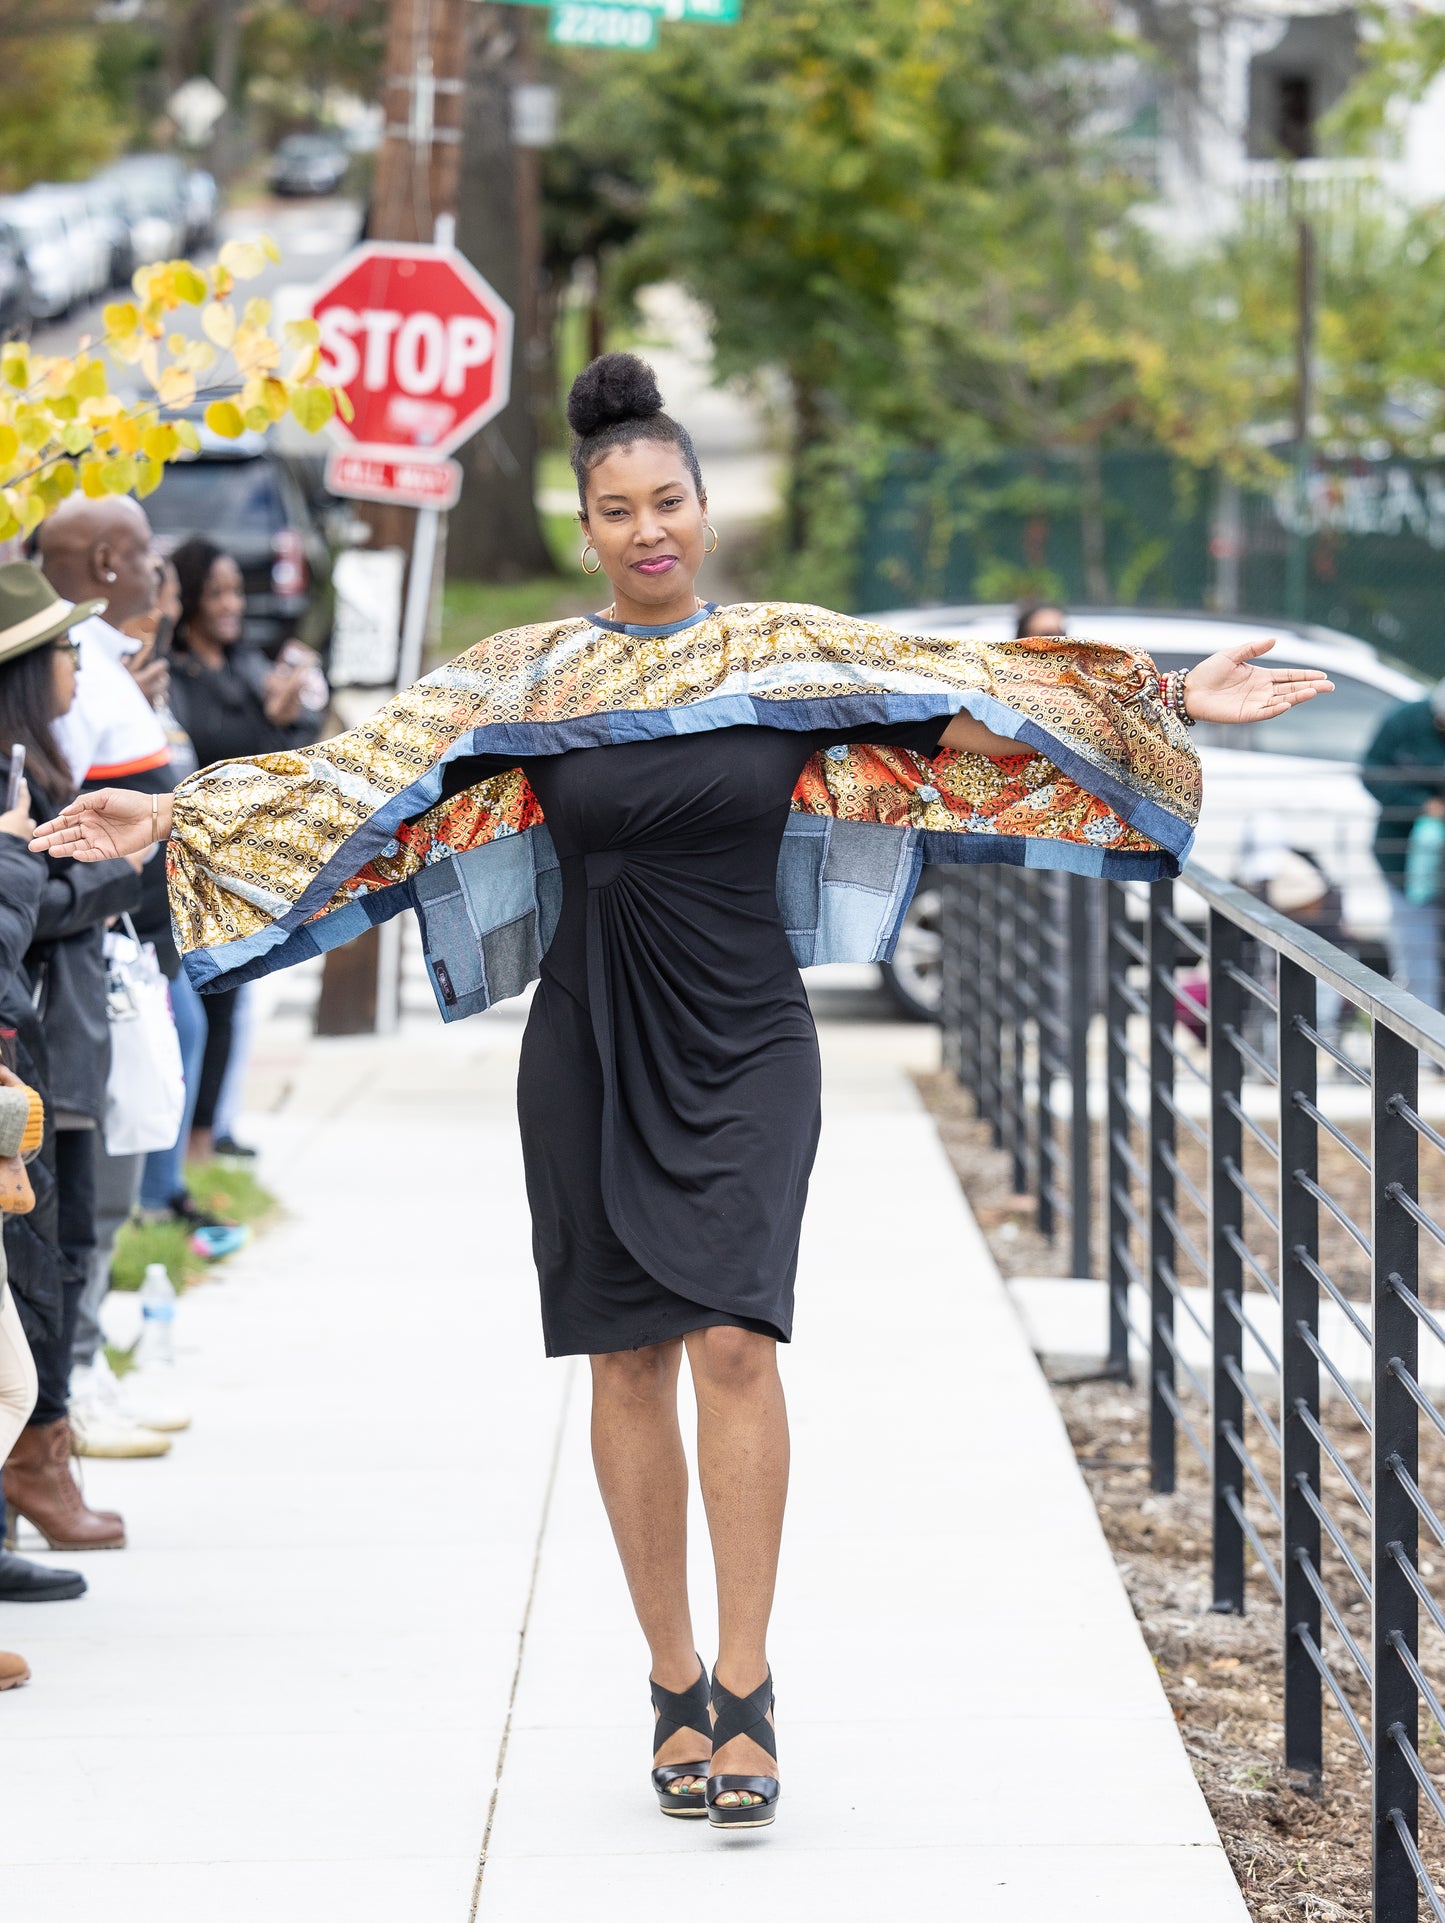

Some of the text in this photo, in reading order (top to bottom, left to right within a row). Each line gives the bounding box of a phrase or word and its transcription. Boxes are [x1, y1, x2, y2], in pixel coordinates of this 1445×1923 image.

[554, 4, 653, 47] 2200
[317, 306, 494, 397] STOP
[338, 457, 385, 486] ALL
